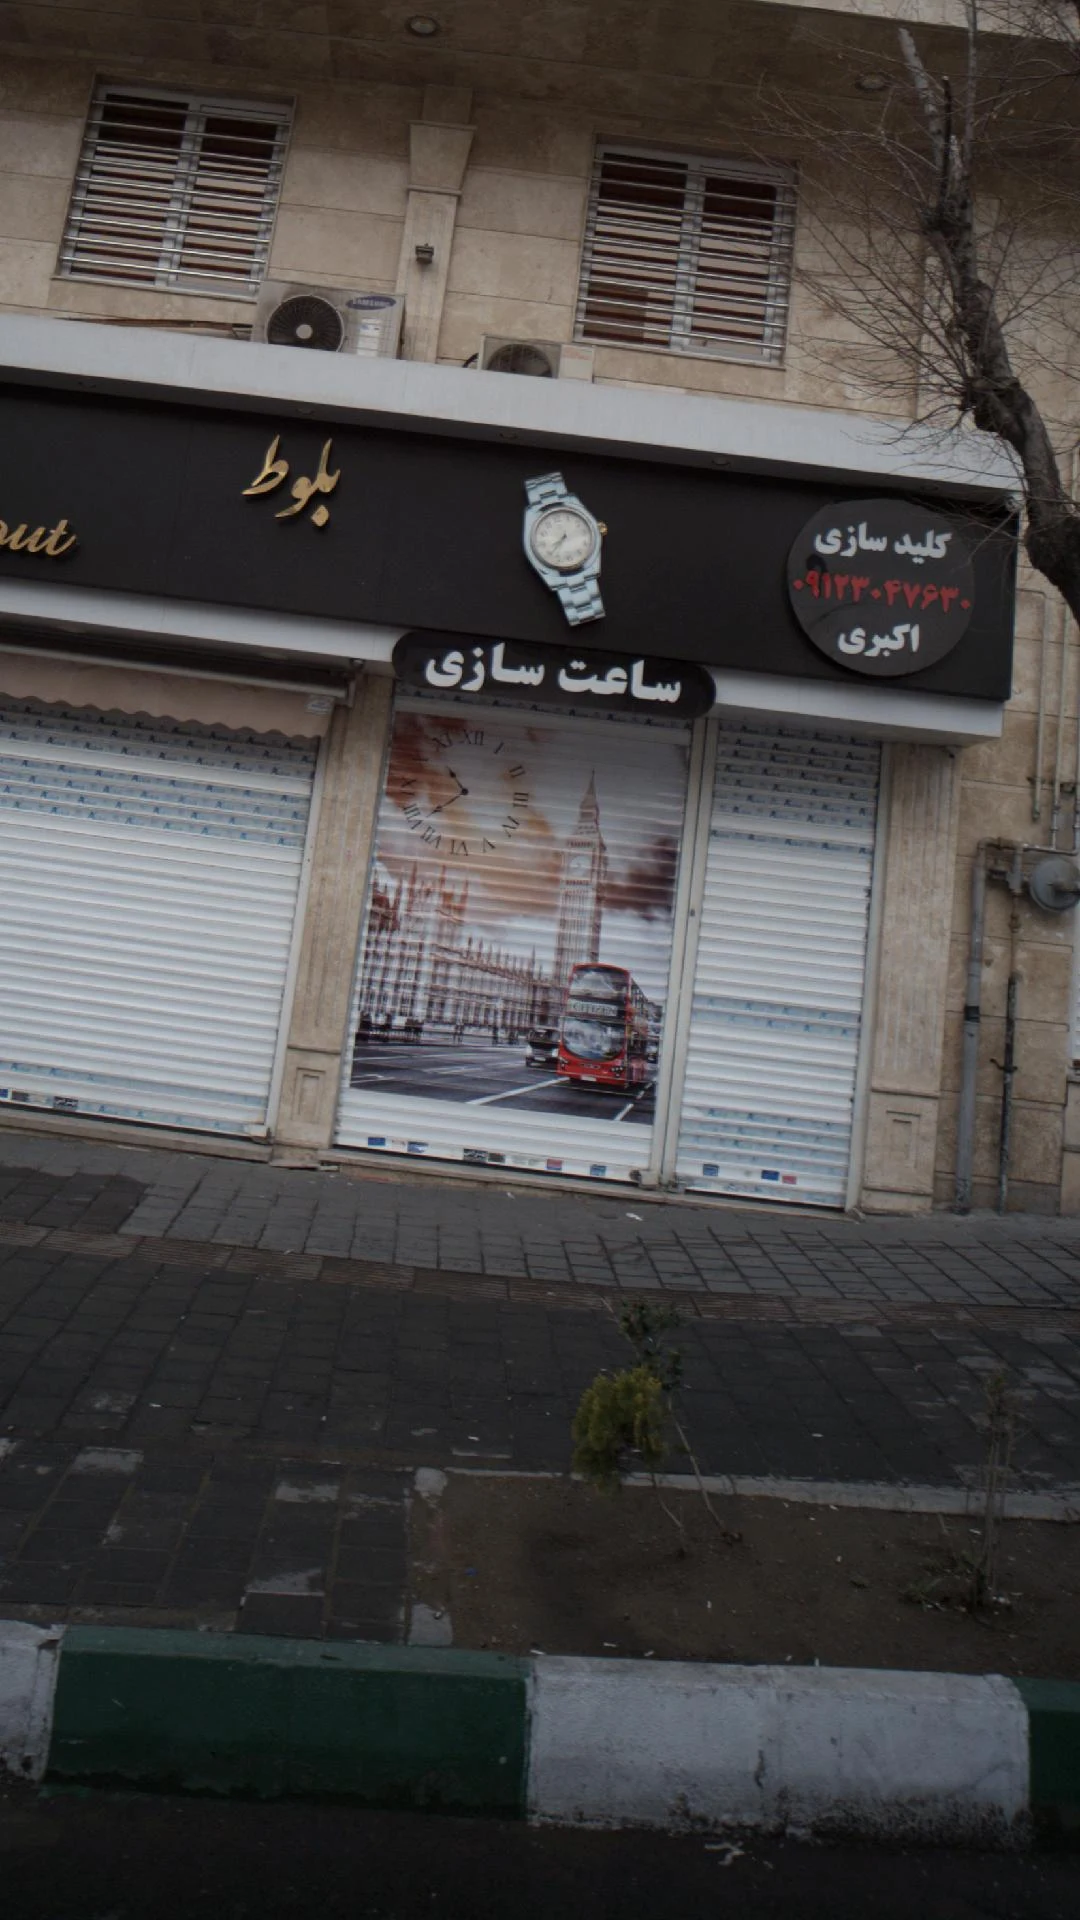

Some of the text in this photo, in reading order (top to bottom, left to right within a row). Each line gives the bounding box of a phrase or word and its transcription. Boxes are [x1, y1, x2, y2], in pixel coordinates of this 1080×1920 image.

[241, 433, 342, 528] بلوط
[813, 521, 953, 565] کلید سازی
[792, 569, 972, 614] ۰۹۱۲۳۰۴۷۶۳۰
[837, 623, 921, 657] اکبری
[423, 642, 682, 705] ساعت سازی
